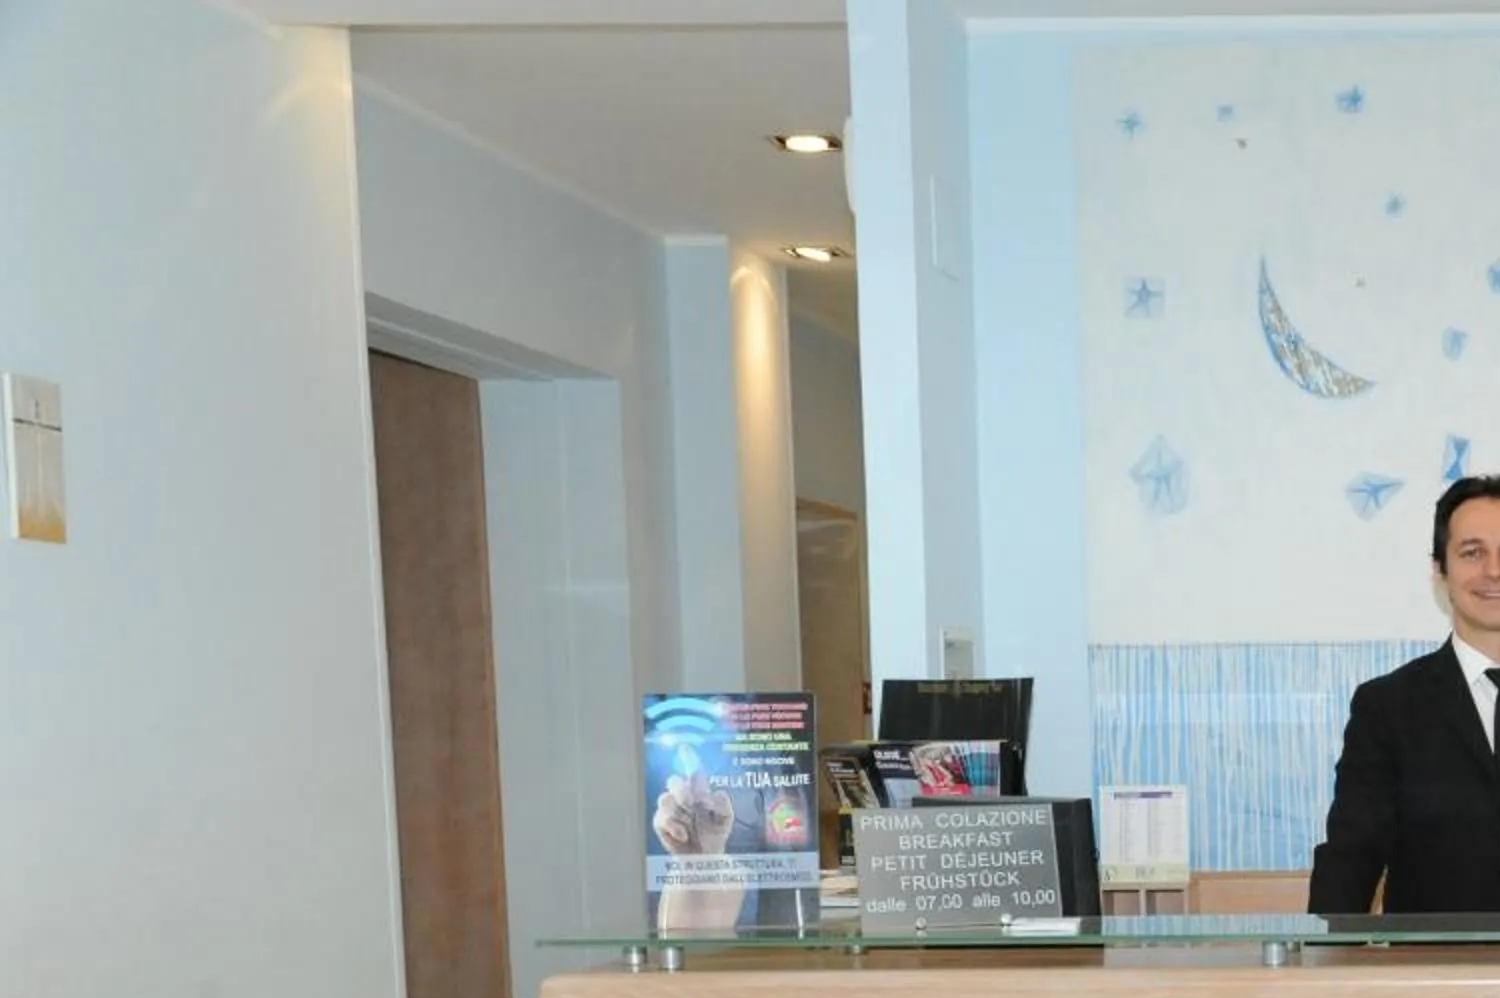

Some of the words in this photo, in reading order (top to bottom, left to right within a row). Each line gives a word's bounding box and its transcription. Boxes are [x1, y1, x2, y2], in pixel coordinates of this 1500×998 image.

[709, 775, 729, 787] PER
[730, 775, 743, 788] LA
[744, 771, 771, 788] TUA
[773, 773, 811, 787] SALUTE
[860, 814, 924, 831] PRIMA
[935, 809, 1048, 829] COLAZIONE
[899, 831, 1013, 850] BREAKFAST
[870, 854, 927, 872] PETIT
[901, 870, 1021, 892] FRÜHSTÜCK
[865, 897, 908, 914] dalle
[915, 894, 964, 911] 07,00
[972, 891, 1001, 908] alle
[1011, 889, 1056, 908] 10,00
